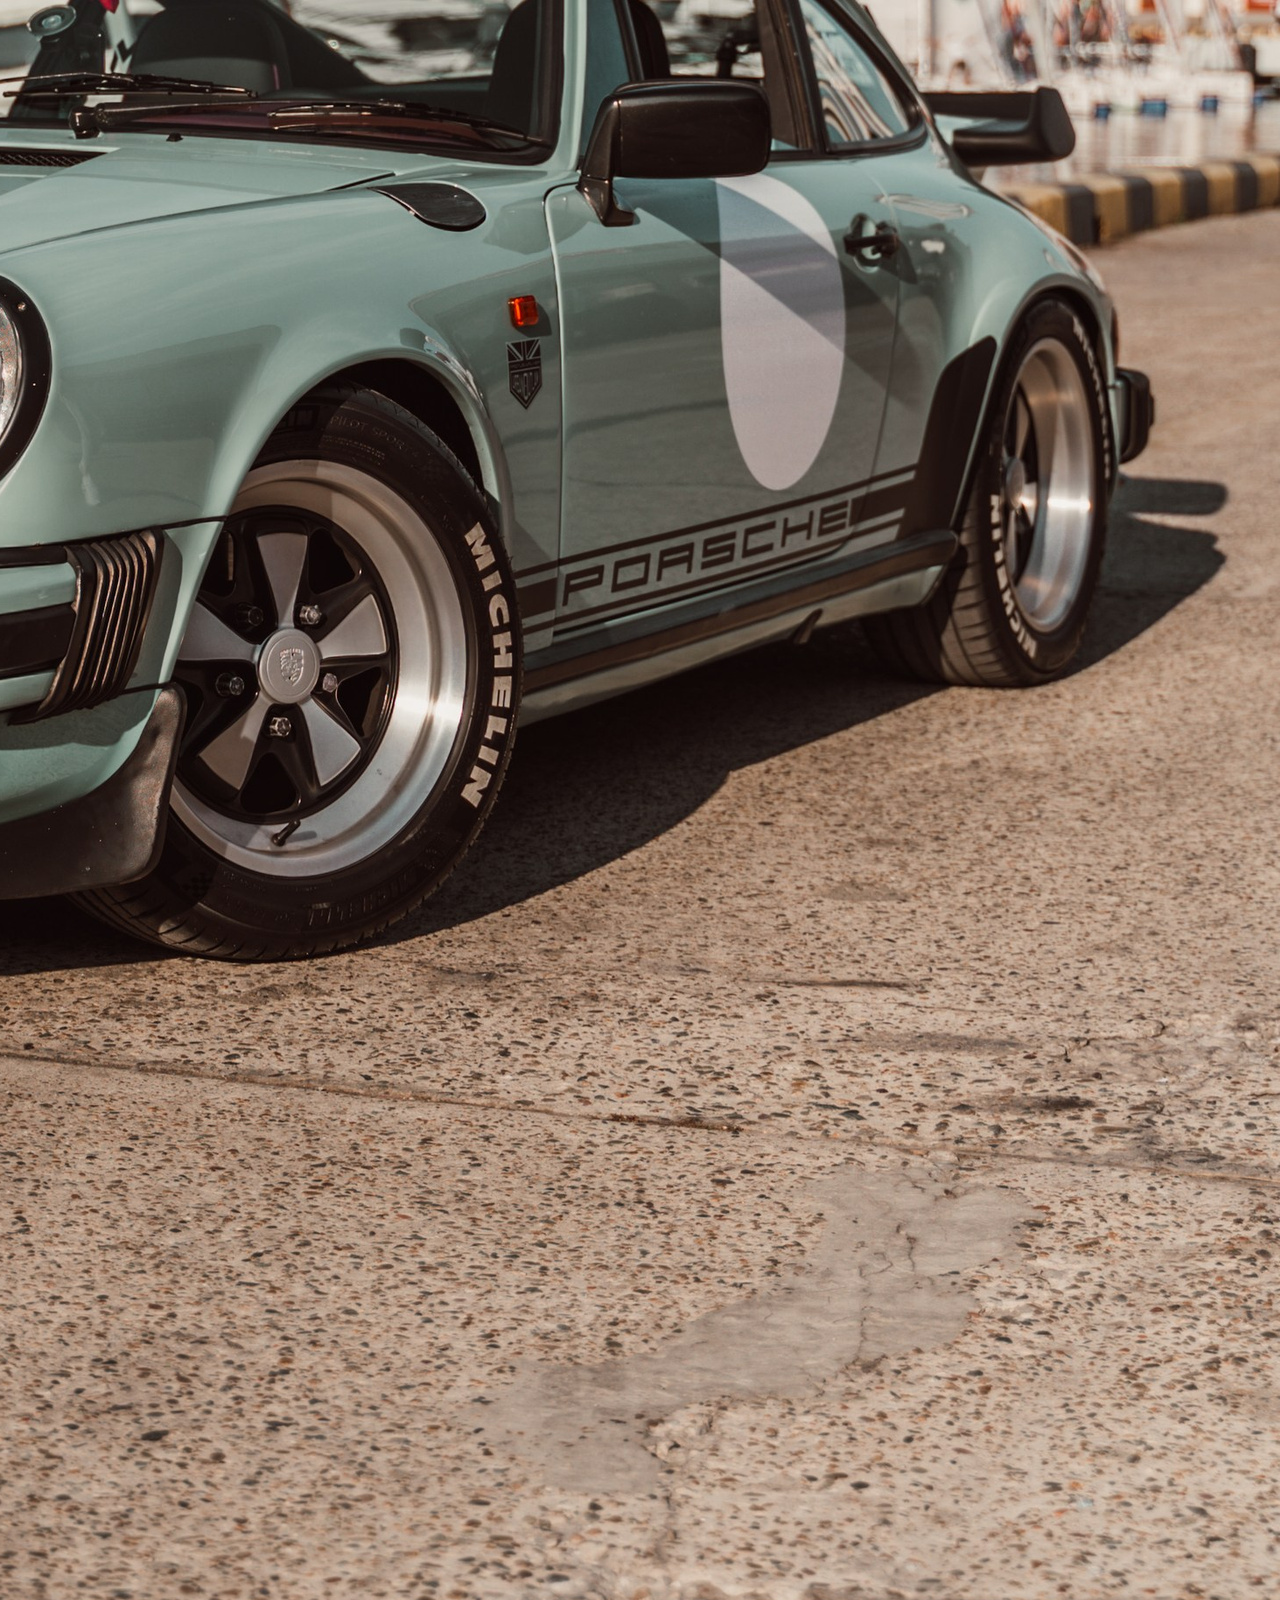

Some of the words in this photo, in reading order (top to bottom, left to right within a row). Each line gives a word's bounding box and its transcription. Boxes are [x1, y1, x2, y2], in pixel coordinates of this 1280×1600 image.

[371, 426, 409, 452] SPOR
[562, 500, 849, 607] PORSCHE
[460, 521, 514, 808] MICHELIN
